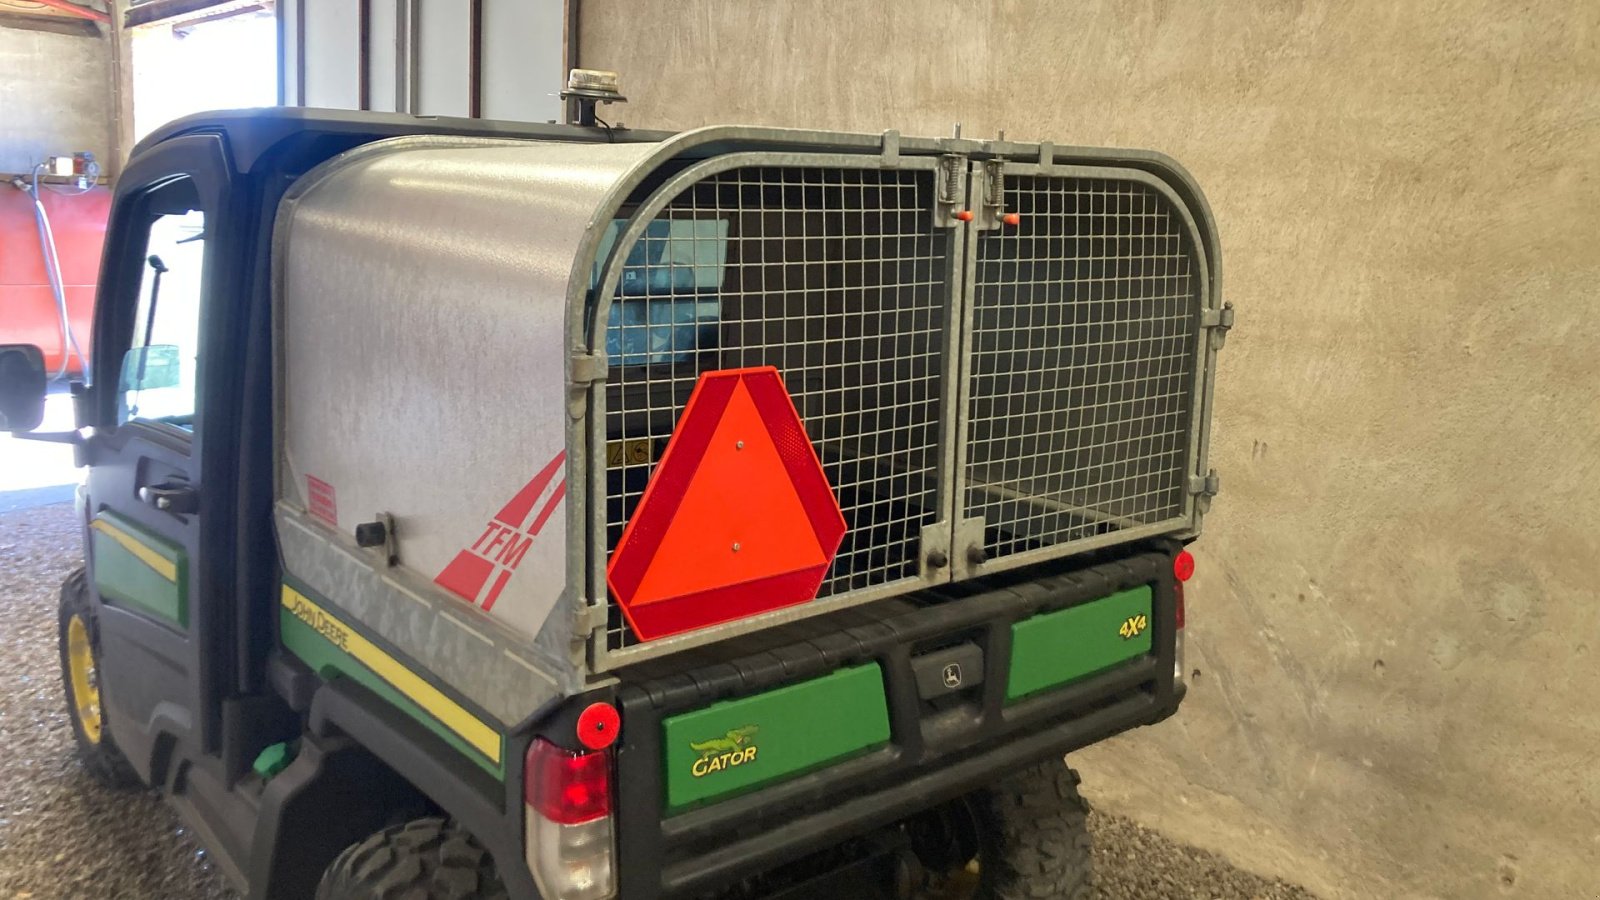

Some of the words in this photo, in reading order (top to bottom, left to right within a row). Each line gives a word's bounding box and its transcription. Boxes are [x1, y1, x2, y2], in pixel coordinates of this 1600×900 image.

[471, 521, 533, 570] TFM
[292, 595, 317, 627] JOHN
[317, 611, 348, 649] DEERE
[692, 746, 757, 777] GATOR
